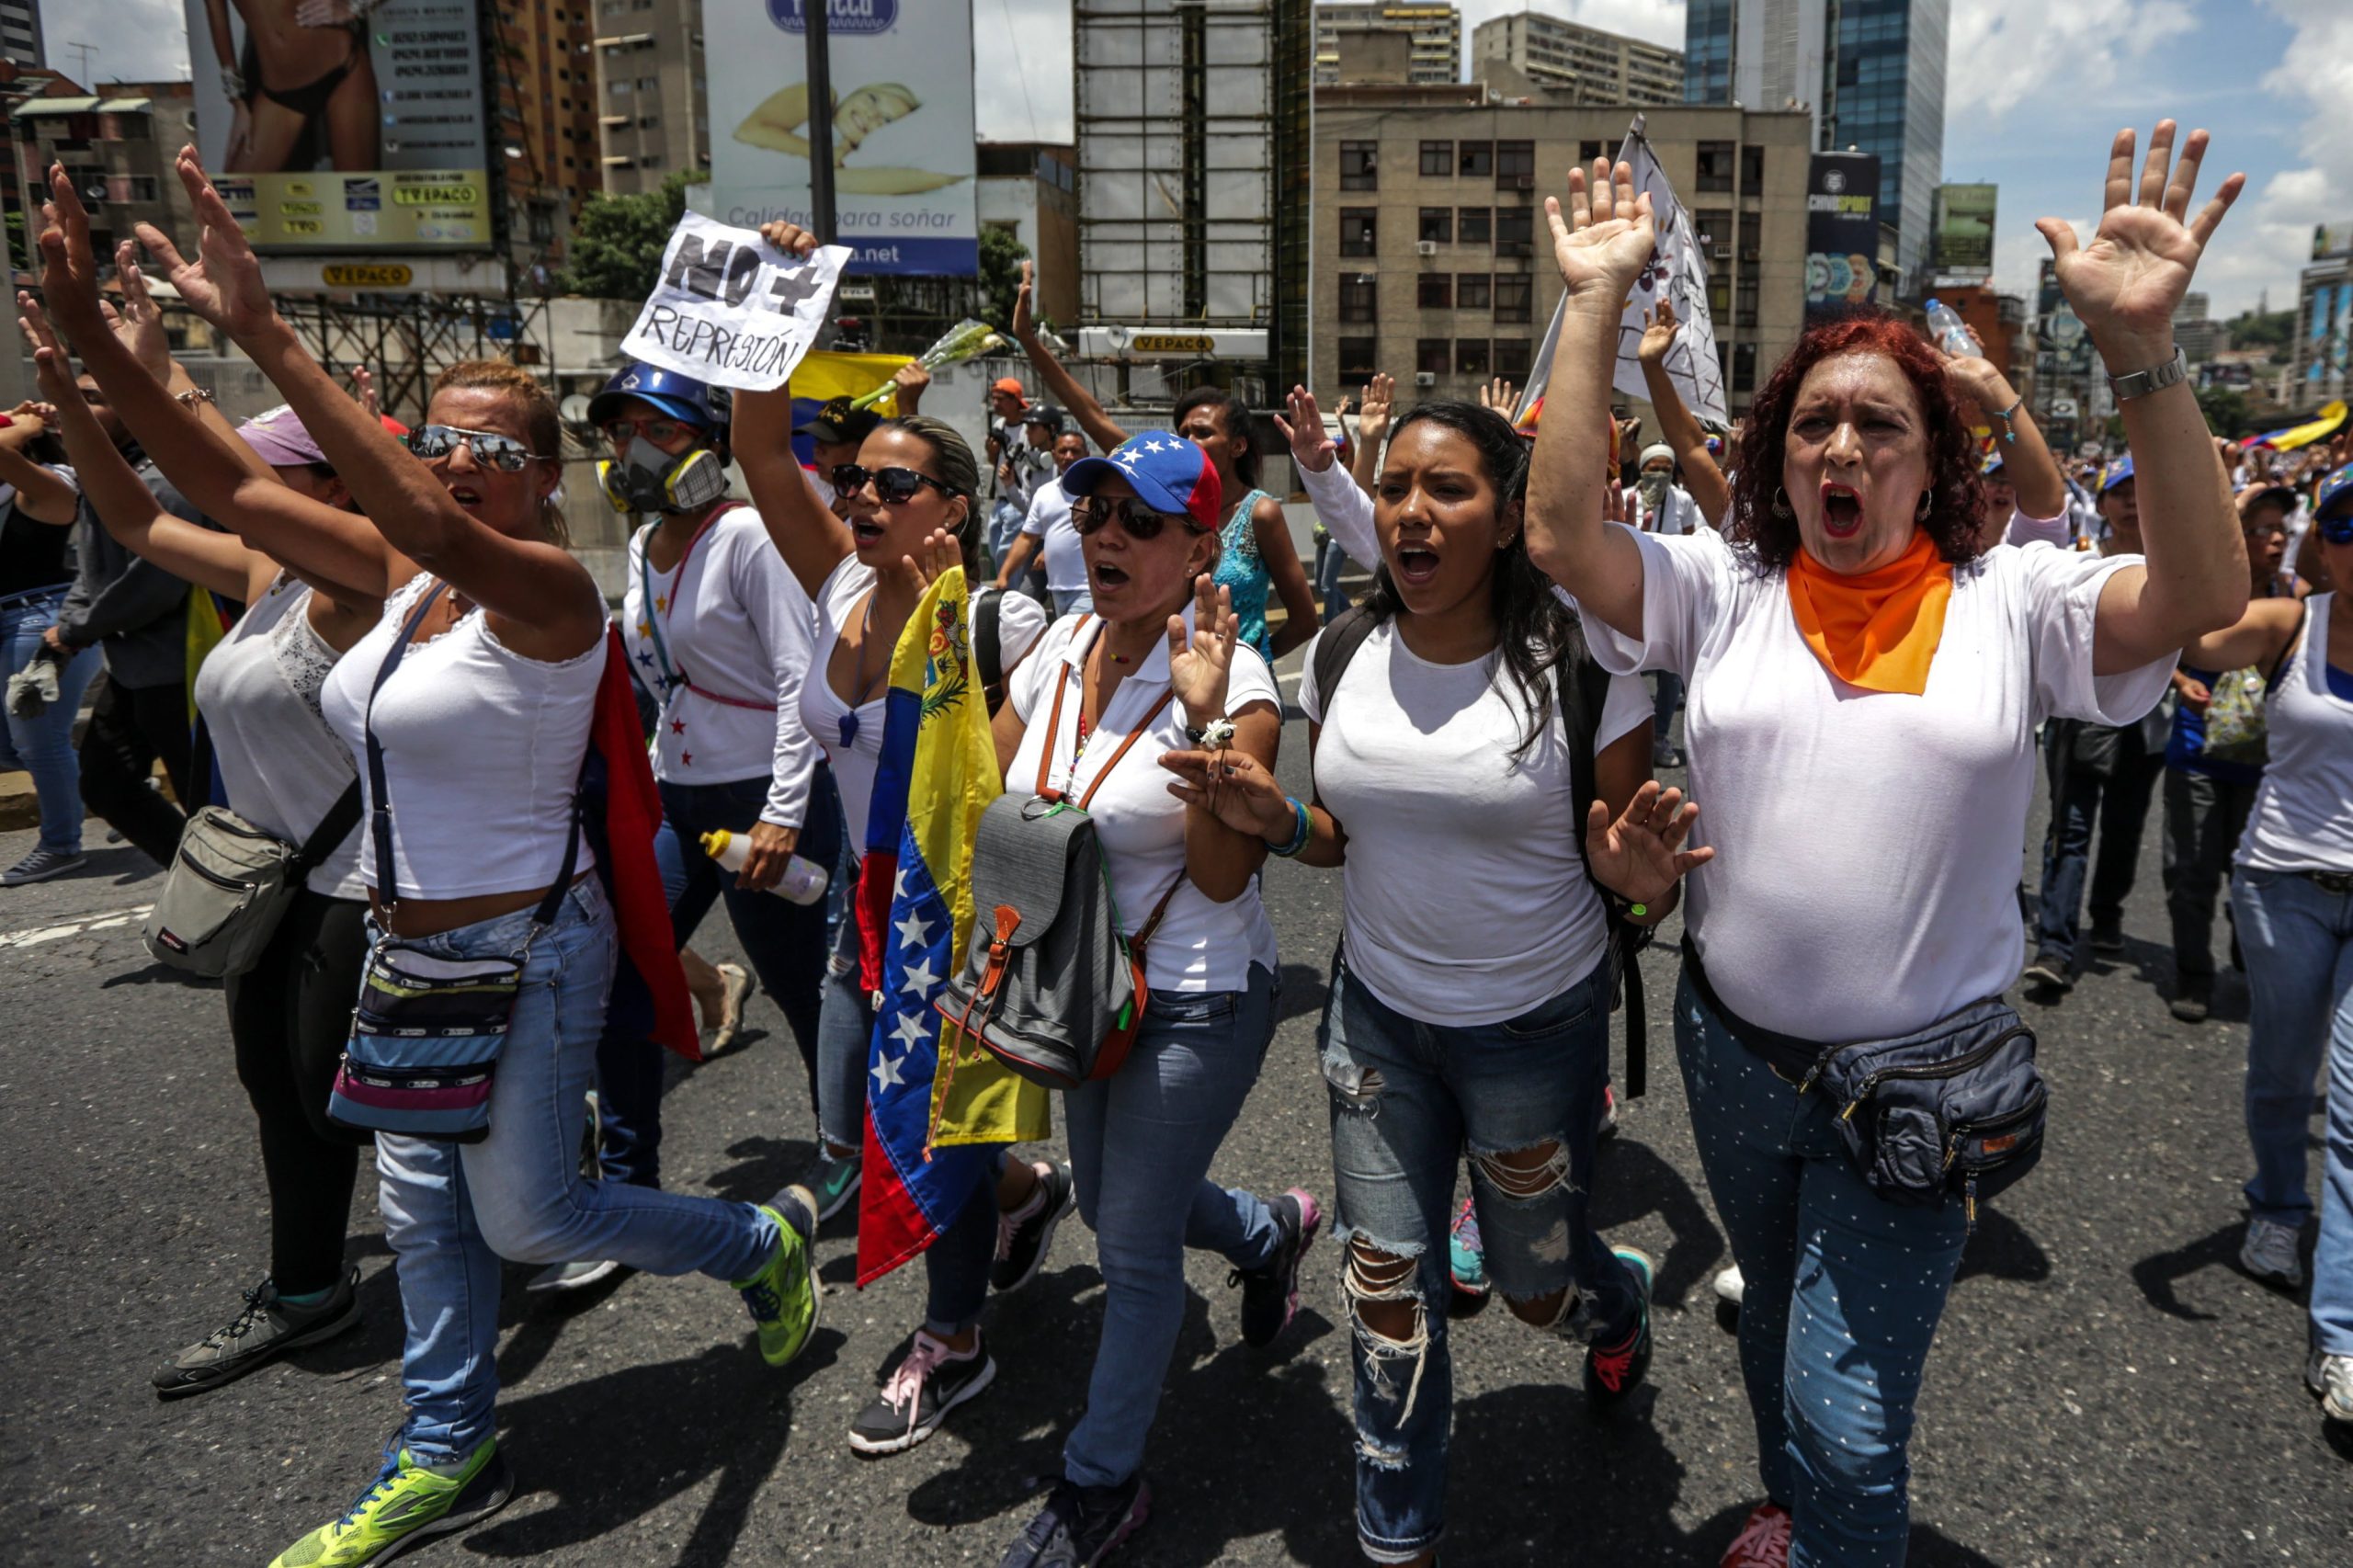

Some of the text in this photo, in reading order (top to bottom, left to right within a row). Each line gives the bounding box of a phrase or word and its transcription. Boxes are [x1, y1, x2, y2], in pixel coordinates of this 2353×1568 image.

[890, 208, 955, 227] soñar
[849, 244, 899, 263] a.net
[328, 266, 403, 281] VEPACO
[665, 233, 823, 316] NO +
[641, 304, 800, 376] REPRESIÓN
[1141, 337, 1206, 348] VEPACO
